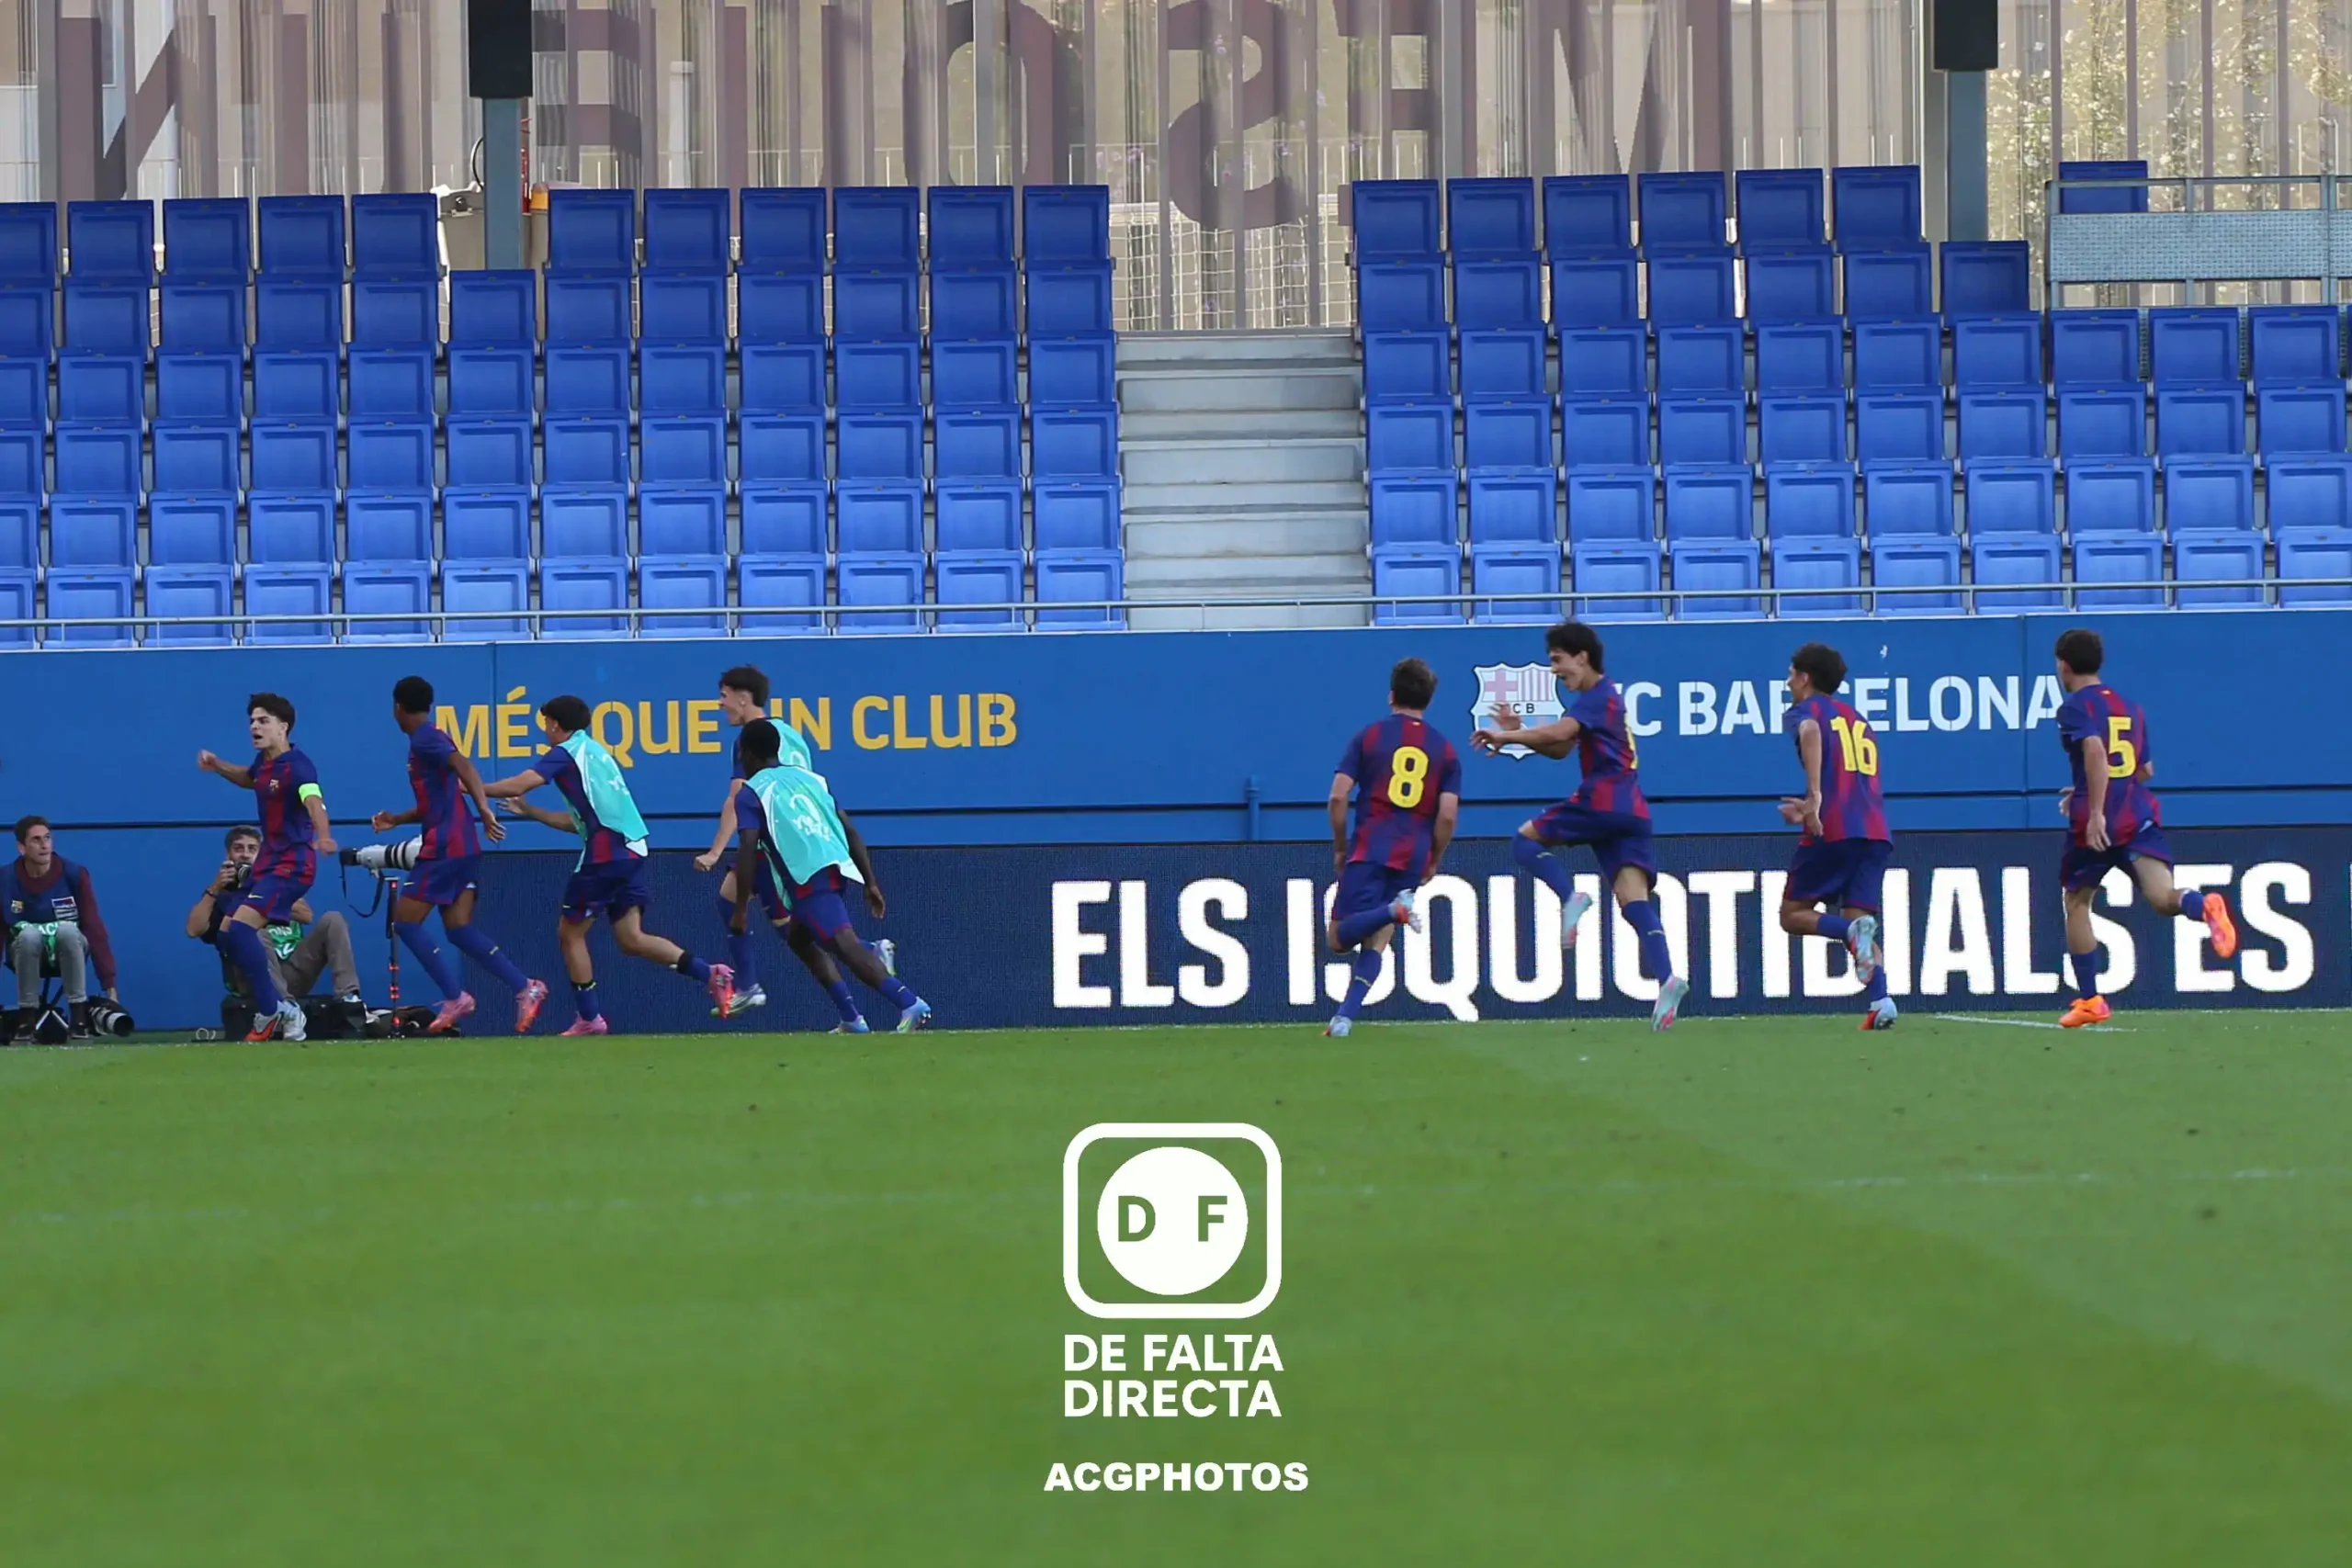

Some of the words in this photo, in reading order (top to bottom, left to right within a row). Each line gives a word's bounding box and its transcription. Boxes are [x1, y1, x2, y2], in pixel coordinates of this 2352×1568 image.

[592, 701, 721, 768] QUE
[770, 697, 831, 750] N
[852, 694, 1017, 750] CLUB
[1612, 682, 1662, 736] C
[1679, 675, 2064, 736] BAELONA
[1830, 716, 1877, 775] 16
[2108, 716, 2136, 778] 5
[1387, 746, 1429, 807] 8
[1052, 878, 1250, 1008] ELS
[2174, 862, 2313, 992] ES
